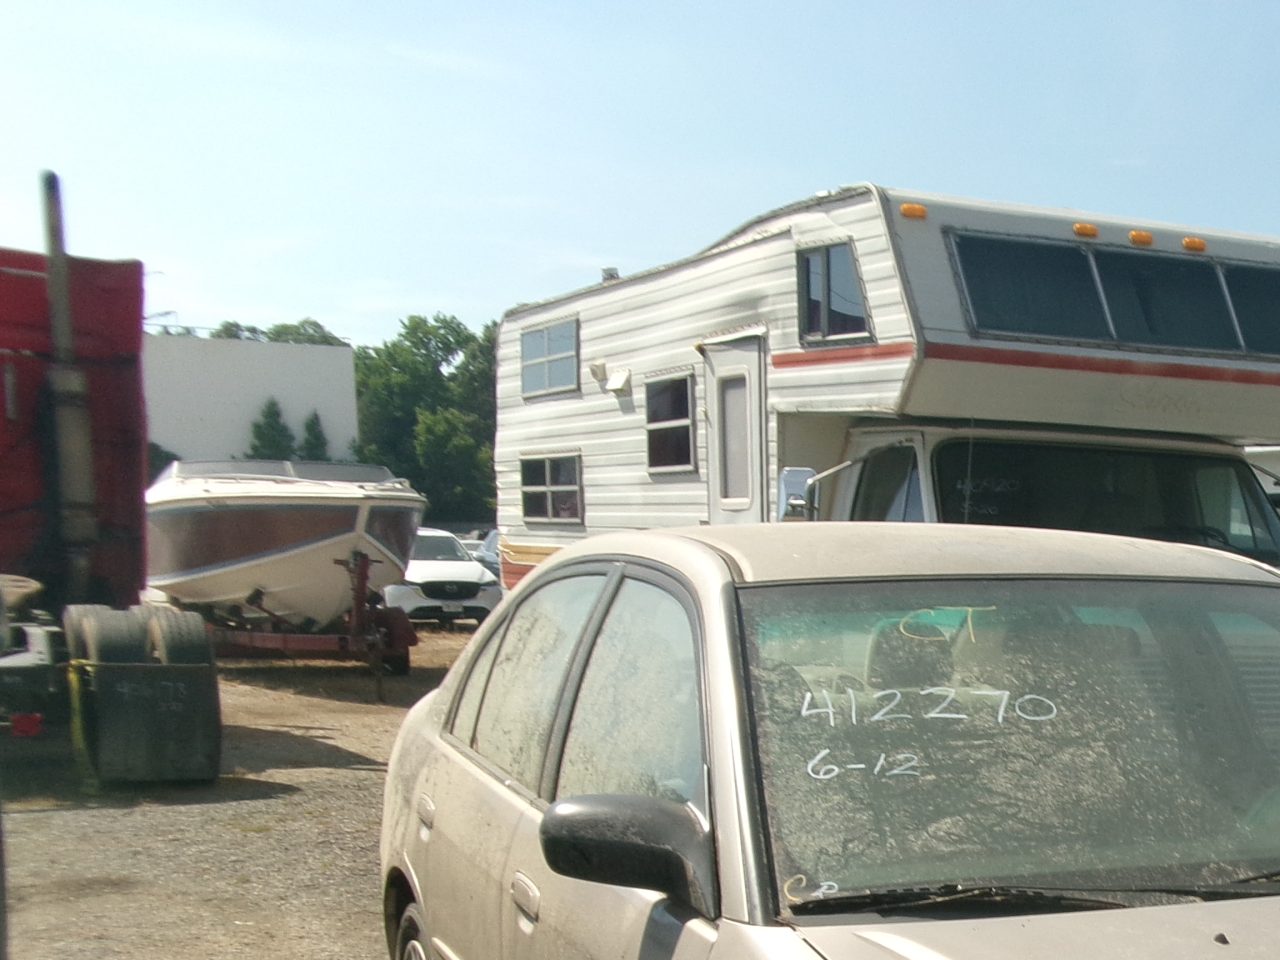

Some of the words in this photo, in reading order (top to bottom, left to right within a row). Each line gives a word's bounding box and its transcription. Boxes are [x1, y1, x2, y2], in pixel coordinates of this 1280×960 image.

[900, 604, 996, 643] CT
[801, 687, 1057, 727] 412270
[807, 748, 921, 780] 6-12
